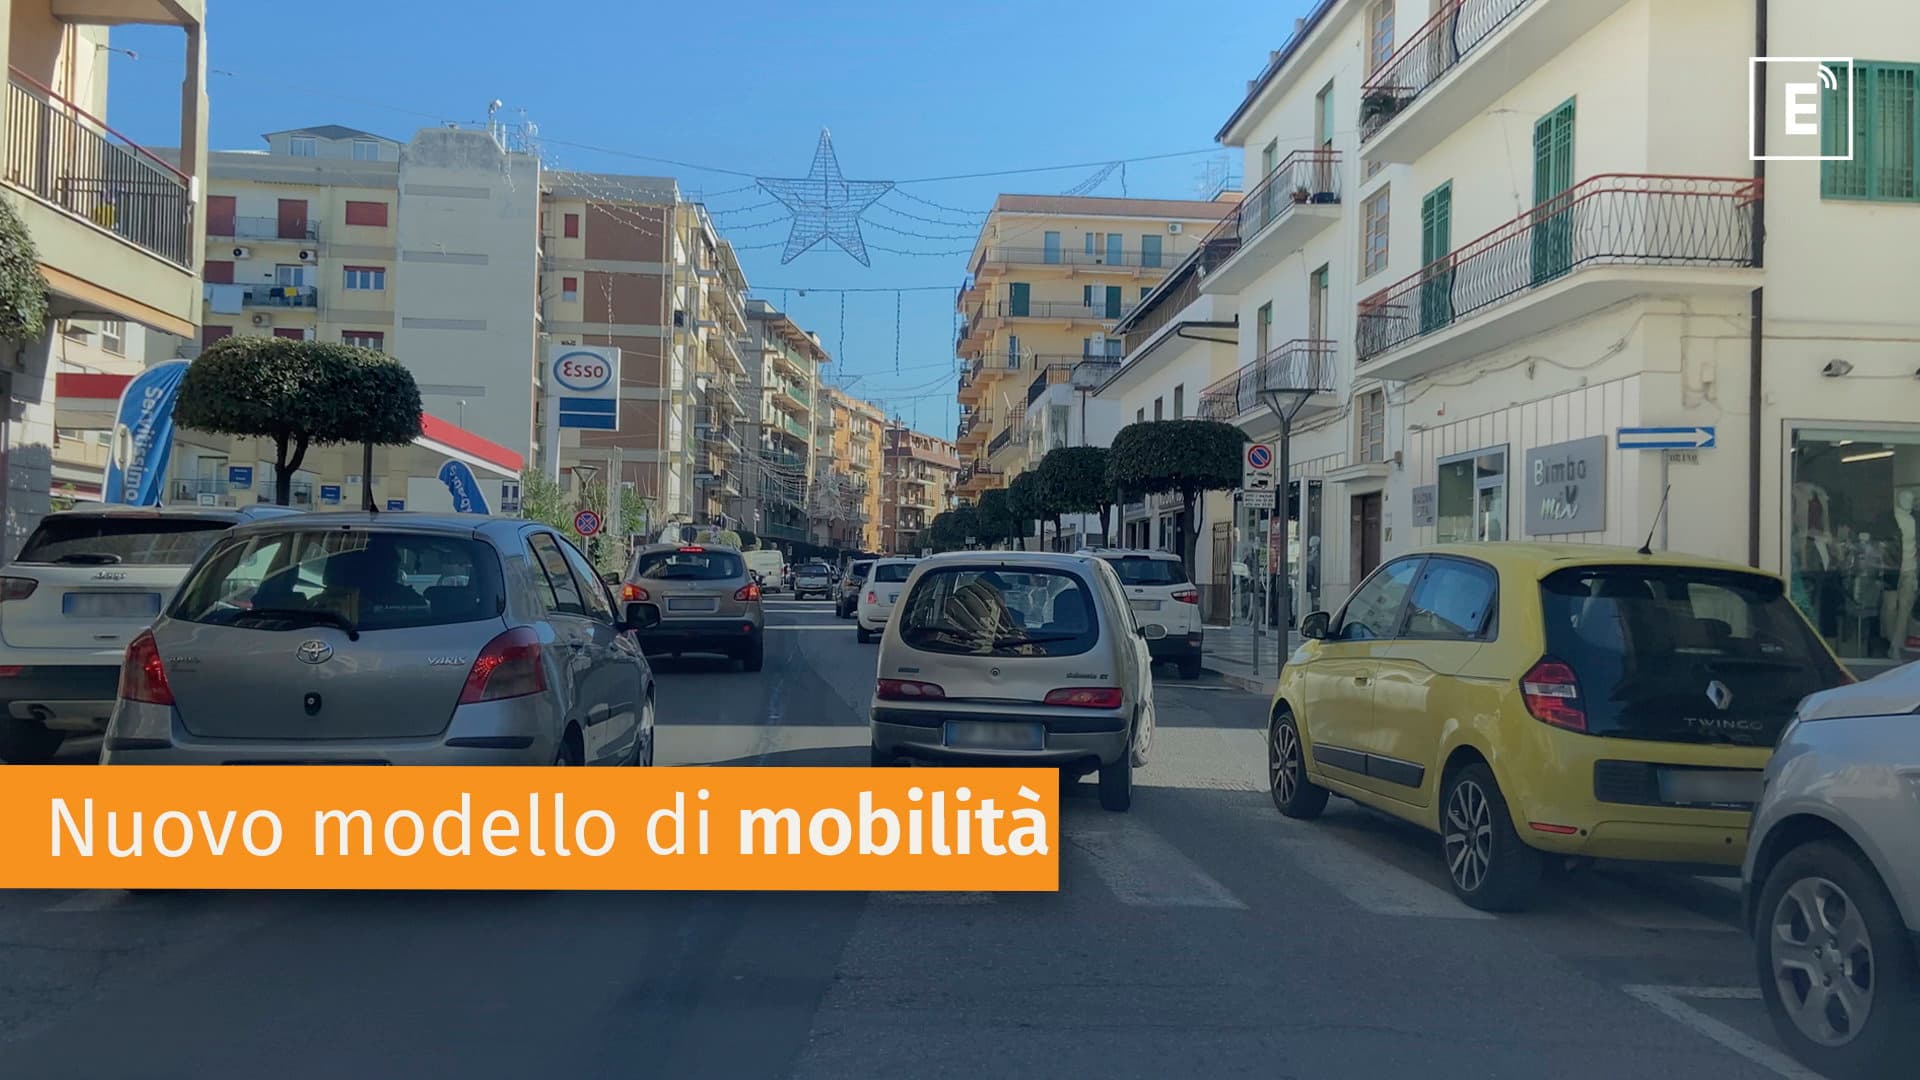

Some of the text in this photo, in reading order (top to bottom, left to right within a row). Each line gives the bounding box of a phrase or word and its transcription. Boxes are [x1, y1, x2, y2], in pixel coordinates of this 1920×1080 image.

[563, 361, 604, 378] Esso
[1534, 455, 1587, 487] Bimbo
[427, 656, 465, 666] YARIS
[1683, 717, 1764, 730] TWINGO
